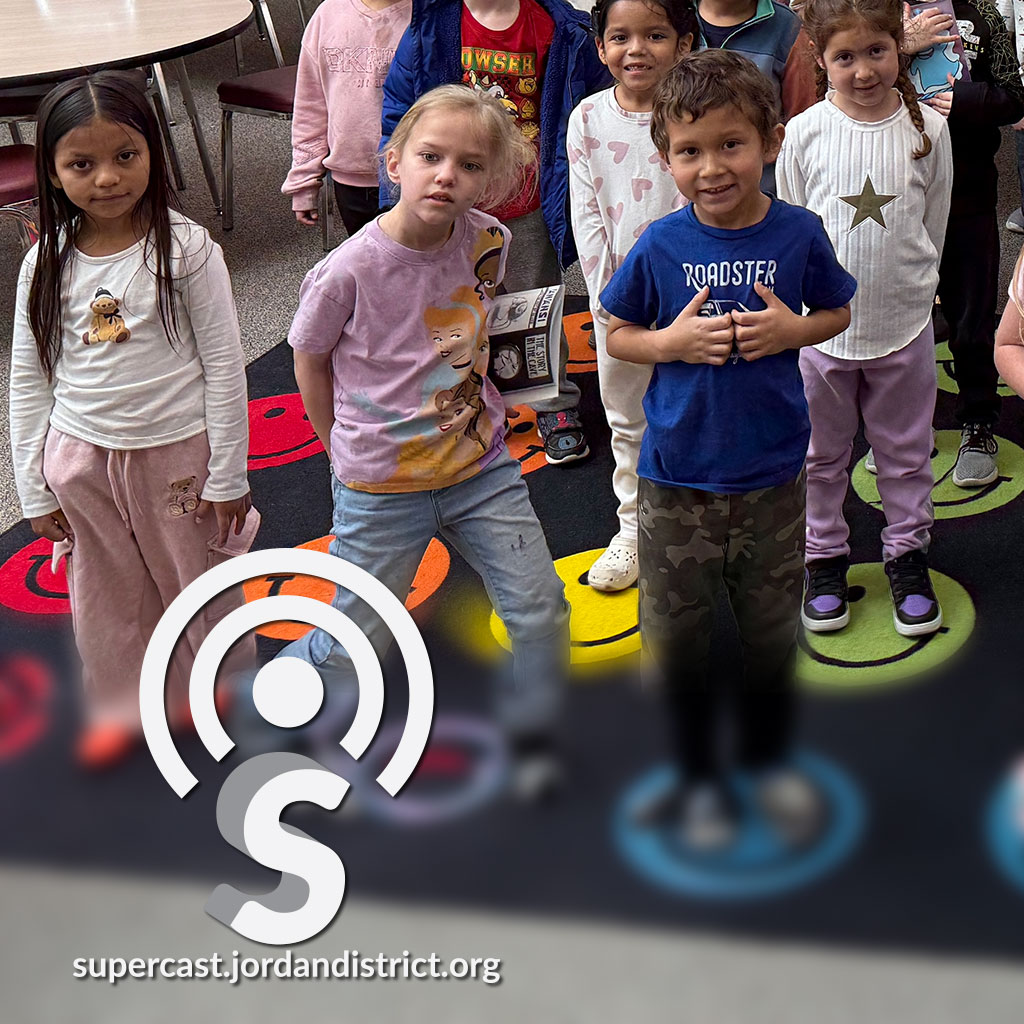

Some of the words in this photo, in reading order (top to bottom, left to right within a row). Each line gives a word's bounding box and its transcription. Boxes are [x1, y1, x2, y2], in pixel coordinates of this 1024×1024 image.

[461, 47, 535, 76] OWSER
[682, 260, 777, 290] ROADSTER
[535, 337, 545, 350] THE
[528, 359, 537, 377] CAVE
[536, 350, 547, 372] STORY
